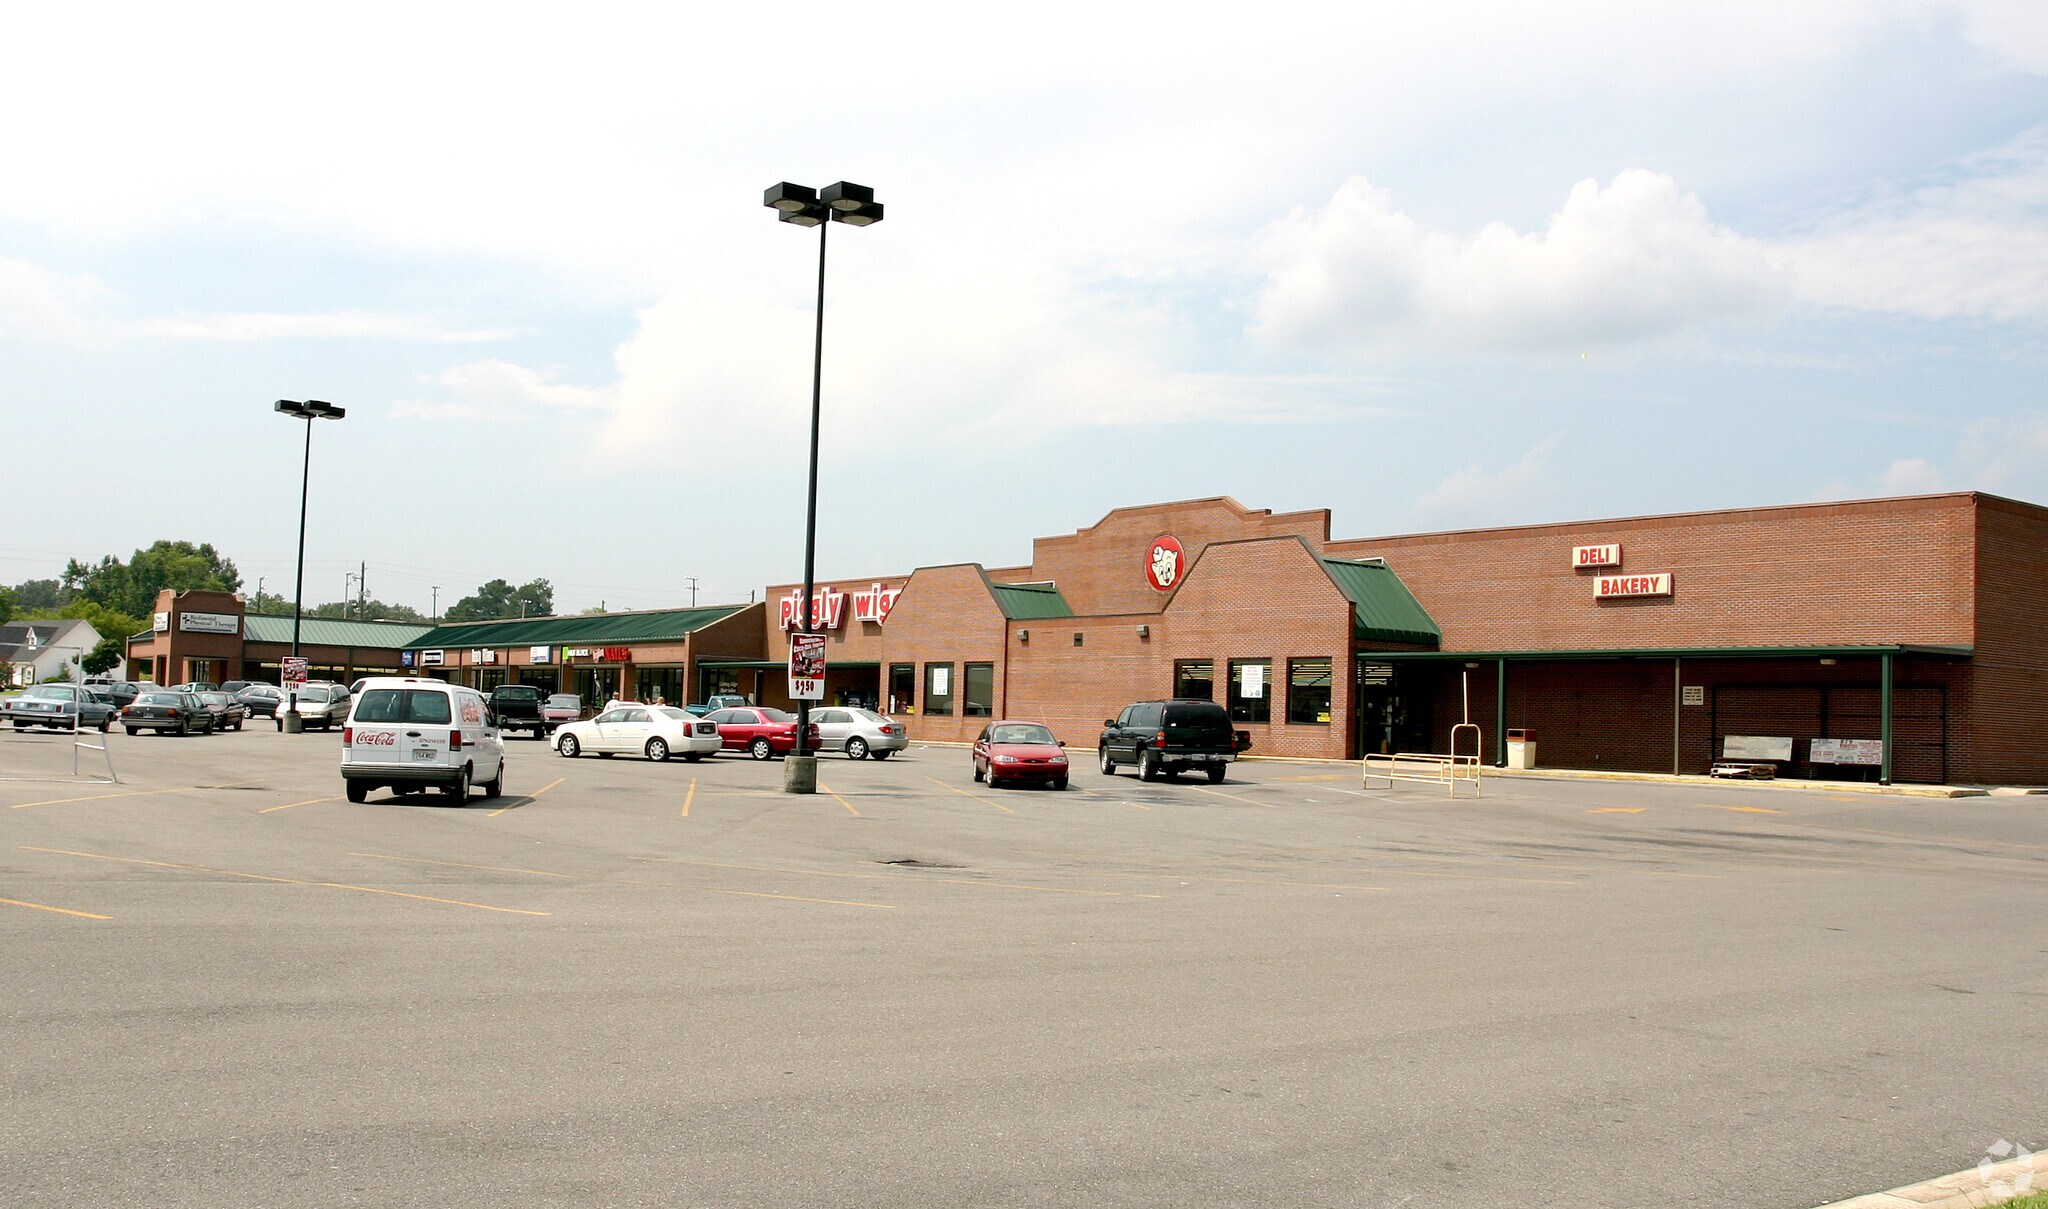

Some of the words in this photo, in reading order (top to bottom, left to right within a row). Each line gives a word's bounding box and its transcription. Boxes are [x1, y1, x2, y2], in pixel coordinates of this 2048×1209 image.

[1580, 548, 1609, 564] DELI
[1601, 577, 1660, 595] BAKERY
[853, 583, 902, 626] wig
